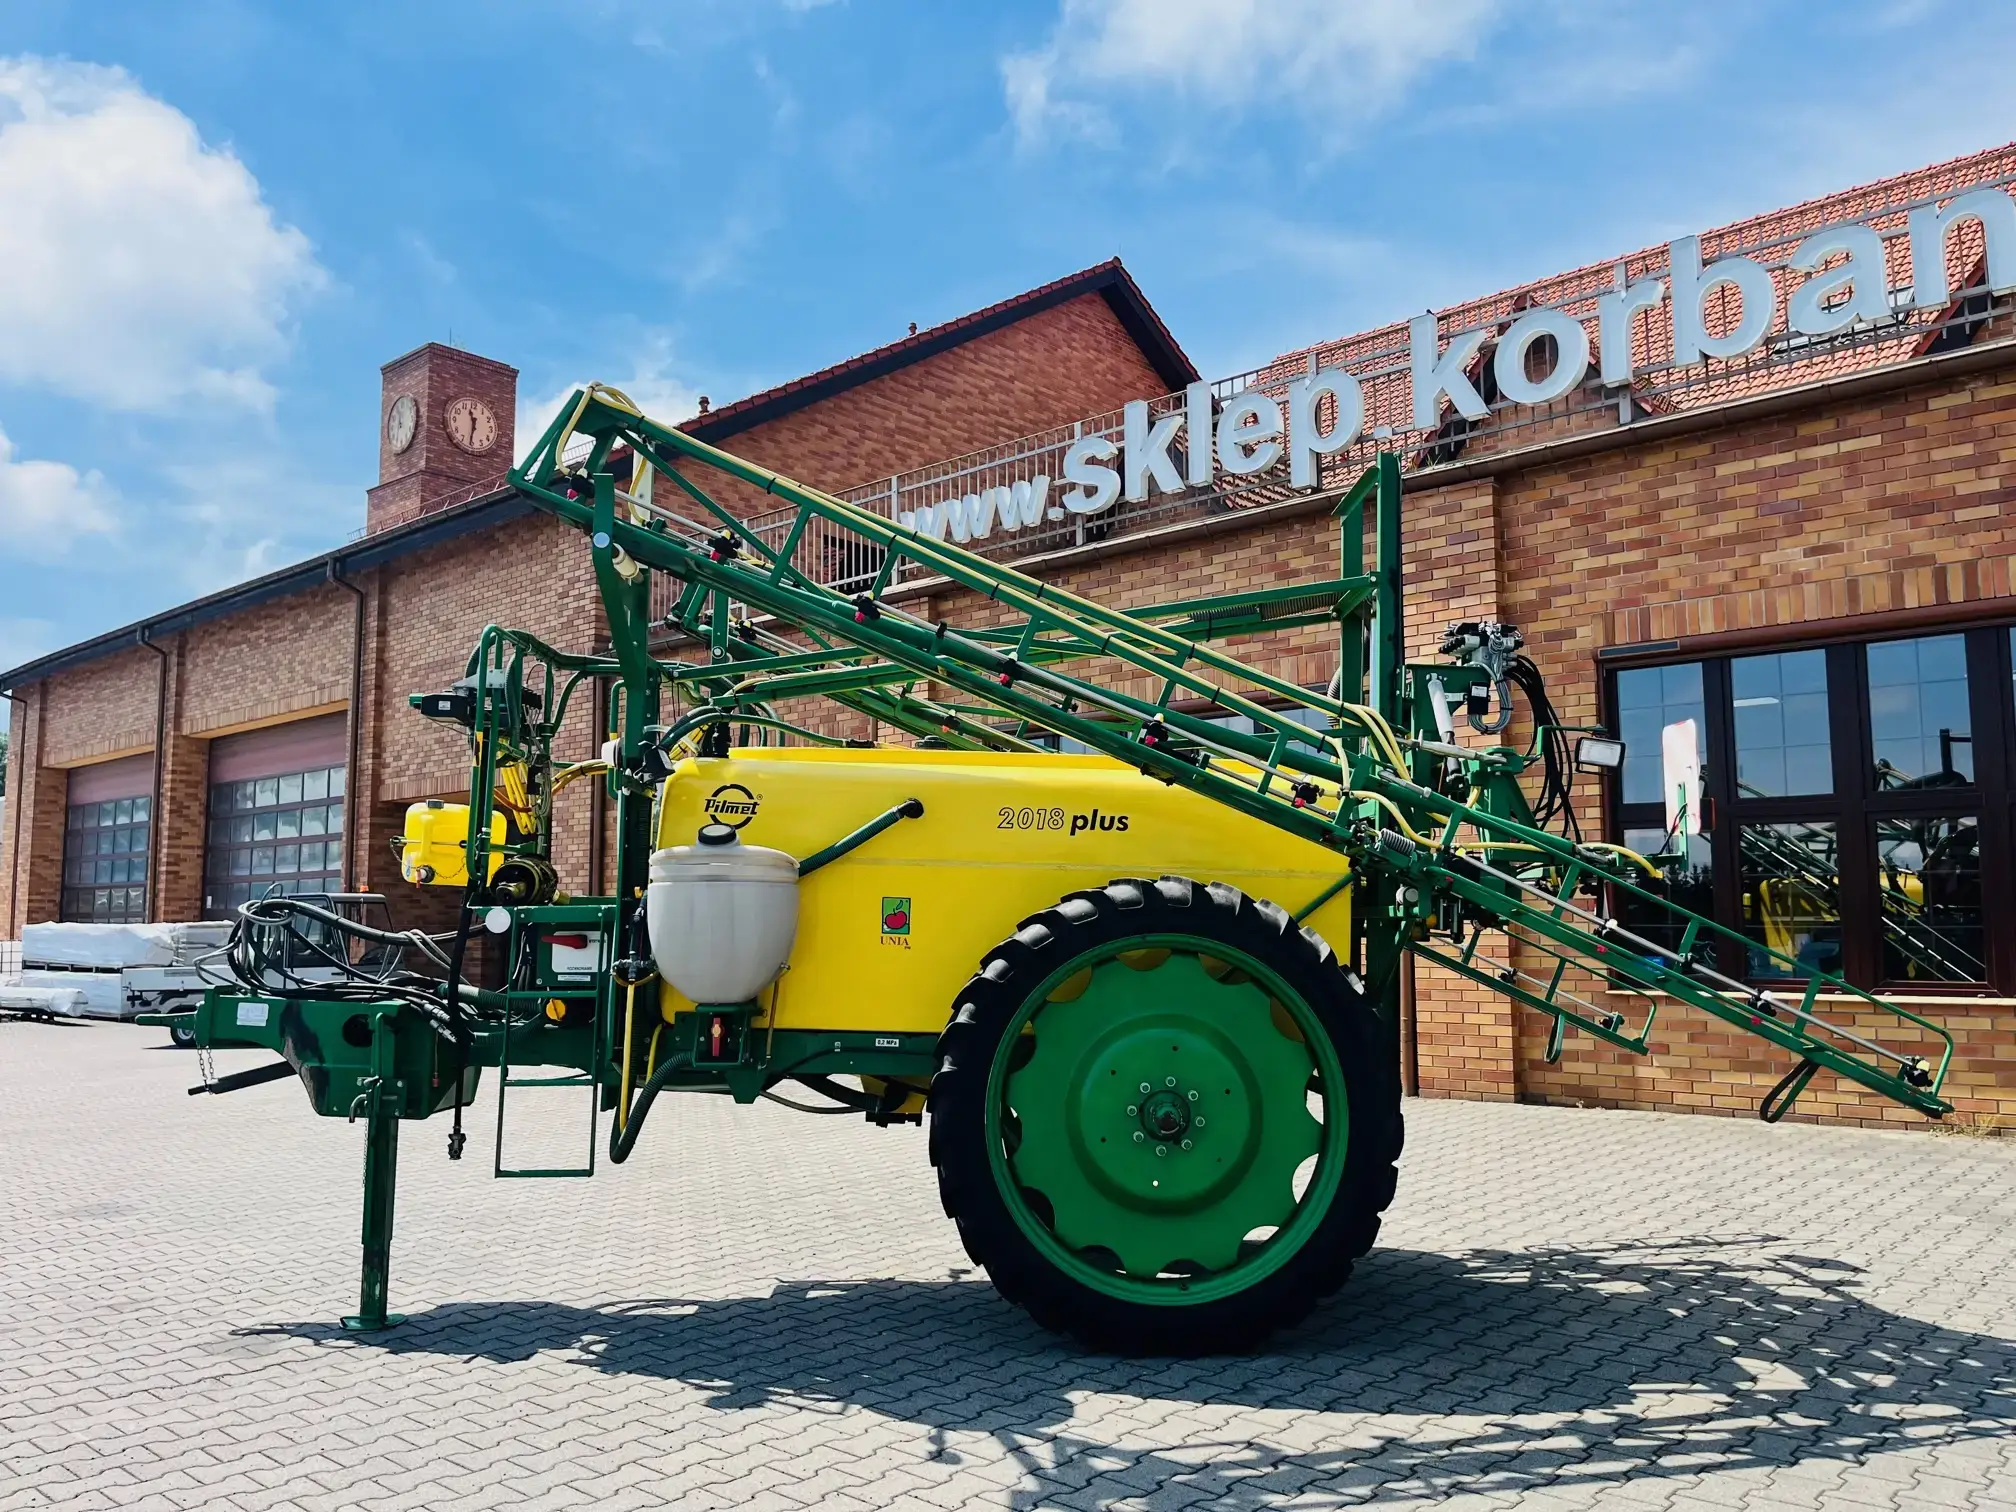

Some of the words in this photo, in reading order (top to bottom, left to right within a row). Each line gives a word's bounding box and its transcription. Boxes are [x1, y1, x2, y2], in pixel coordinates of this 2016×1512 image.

[704, 798, 760, 816] Pilmet
[997, 807, 1065, 831] 2018
[1069, 808, 1129, 836] plus
[880, 936, 910, 946] UNIA
